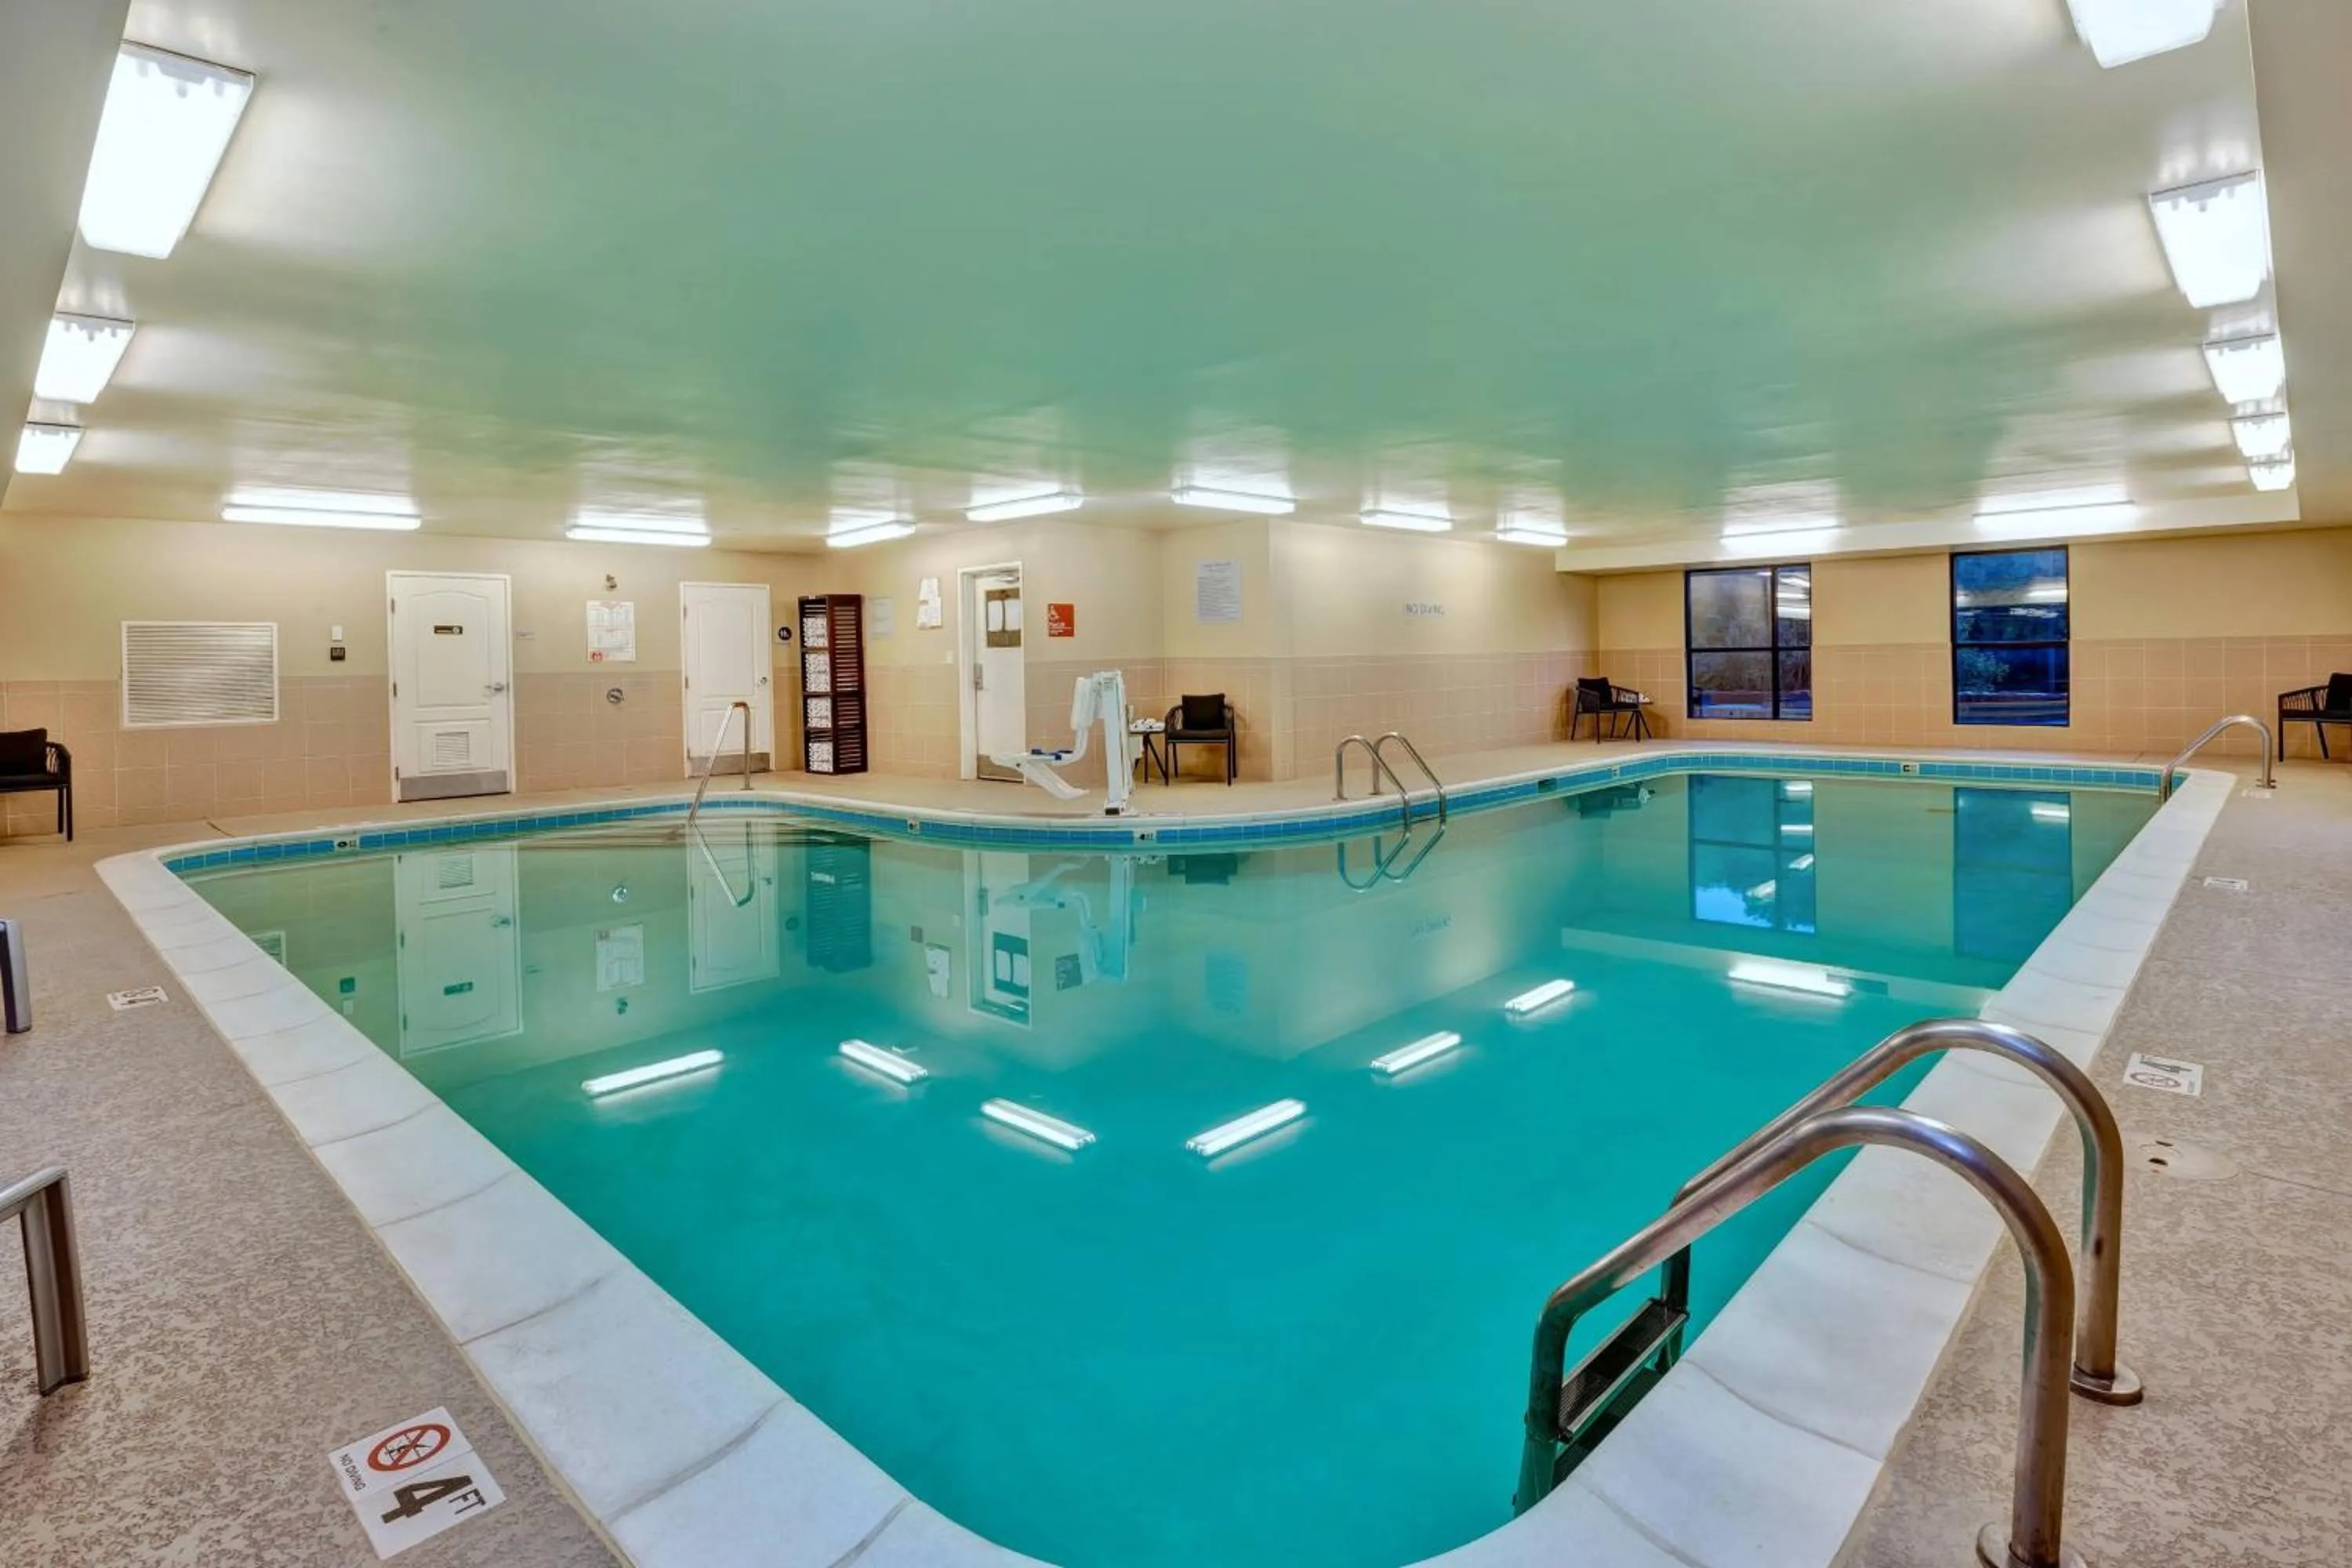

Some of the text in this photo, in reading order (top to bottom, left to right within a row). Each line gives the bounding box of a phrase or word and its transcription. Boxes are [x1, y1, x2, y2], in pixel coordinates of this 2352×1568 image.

[339, 1453, 366, 1492] NO DIVING
[381, 1475, 486, 1524] 4 FT
